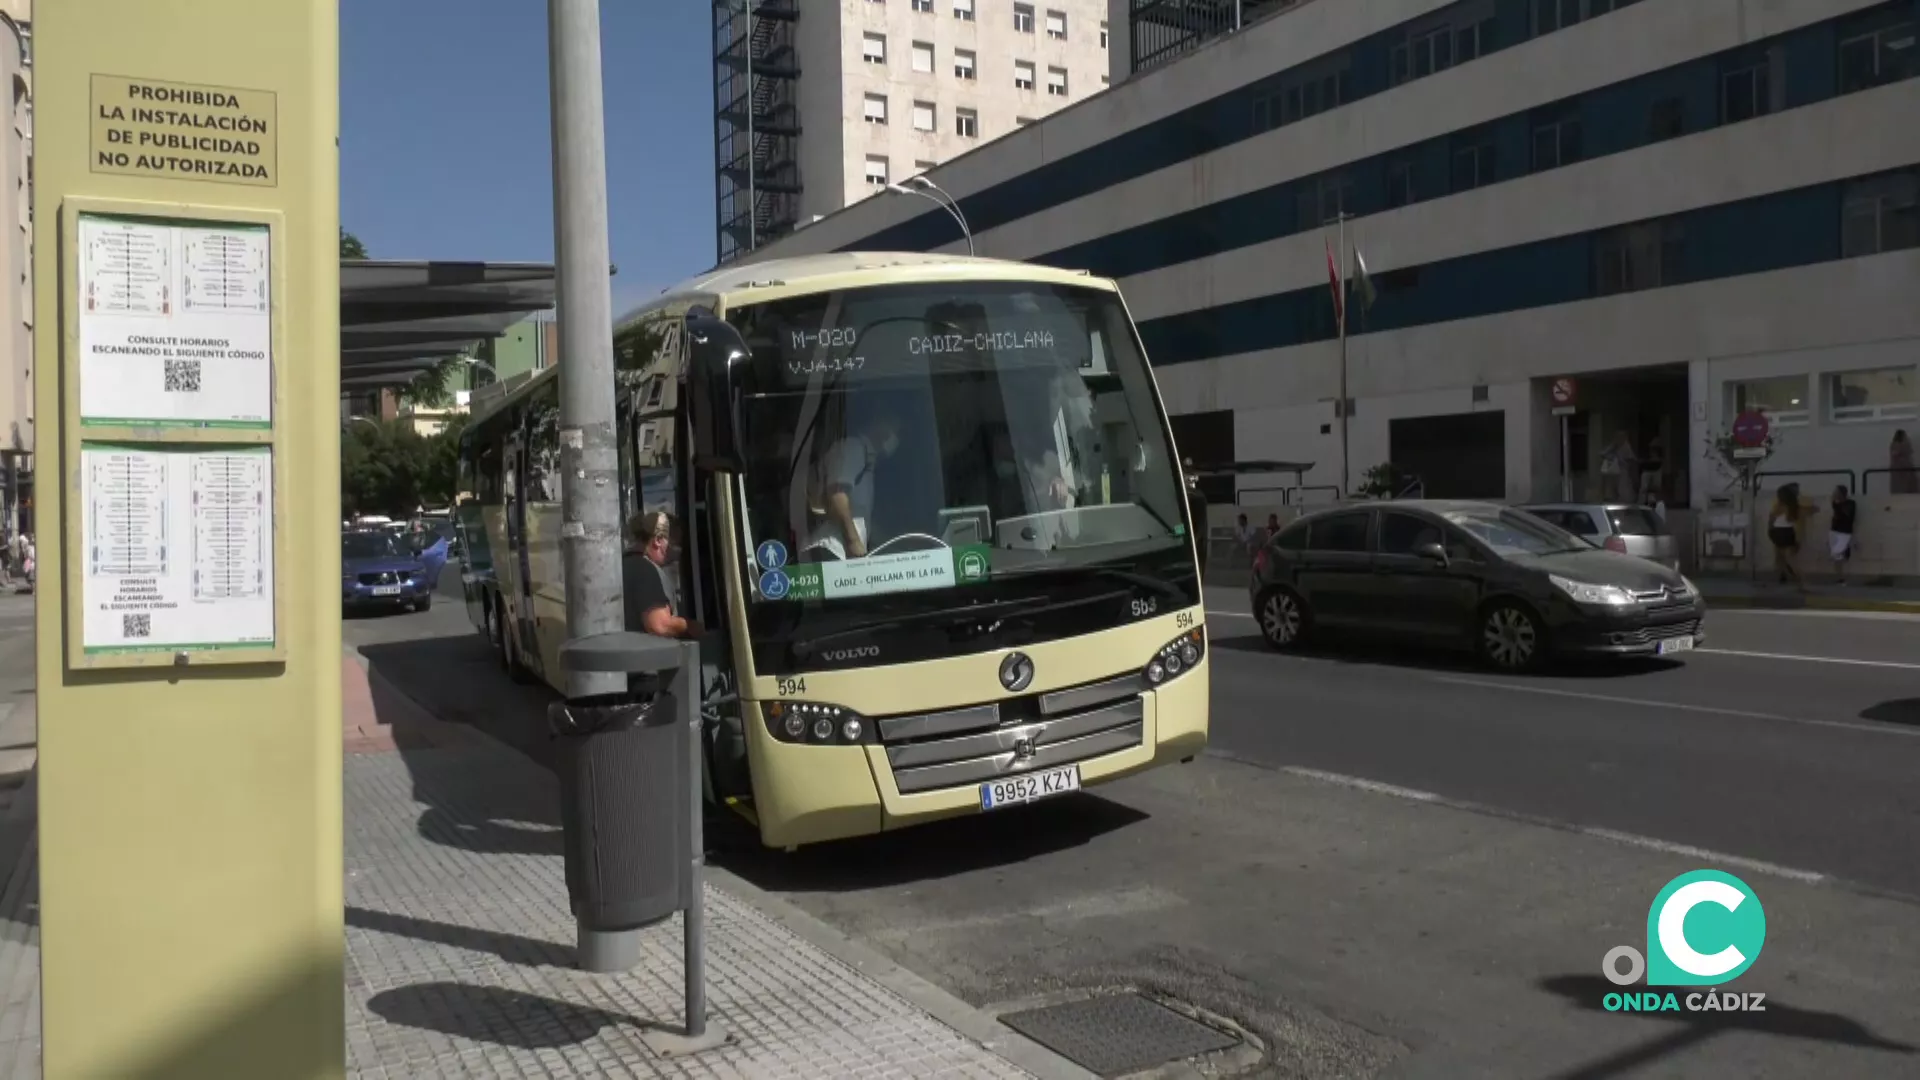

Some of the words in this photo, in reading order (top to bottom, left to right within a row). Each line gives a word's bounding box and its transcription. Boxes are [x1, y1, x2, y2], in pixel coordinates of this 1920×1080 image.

[129, 84, 240, 109] PROHIBIDA
[99, 105, 125, 121] LA
[131, 108, 267, 134] INSTALACIÓN
[107, 129, 133, 144] DE
[139, 132, 261, 156] PUBLICIDAD
[99, 151, 129, 167] NO
[136, 155, 268, 179] AUTORIZADA
[127, 335, 178, 346] CONSULTE
[180, 337, 230, 348] HORARIOS
[791, 327, 856, 350] M-020
[908, 330, 1054, 355] CADIZ-CHICLANA
[92, 345, 161, 357] ESCANEANDO
[163, 347, 174, 357] EL
[176, 348, 226, 359] SIGUIENTE
[227, 347, 265, 360] CÓDIGO
[834, 577, 858, 589] CÁDIZ
[865, 573, 904, 585] CHICLANA
[906, 570, 916, 580] DE
[919, 568, 929, 578] LA
[100, 603, 109, 611] EL
[111, 602, 148, 610] SIGUIENTE
[1176, 611, 1193, 629] 594
[821, 645, 880, 661] VOLVO
[778, 676, 806, 697] 594
[994, 779, 1038, 802] 9952
[1042, 769, 1073, 793] KZY
